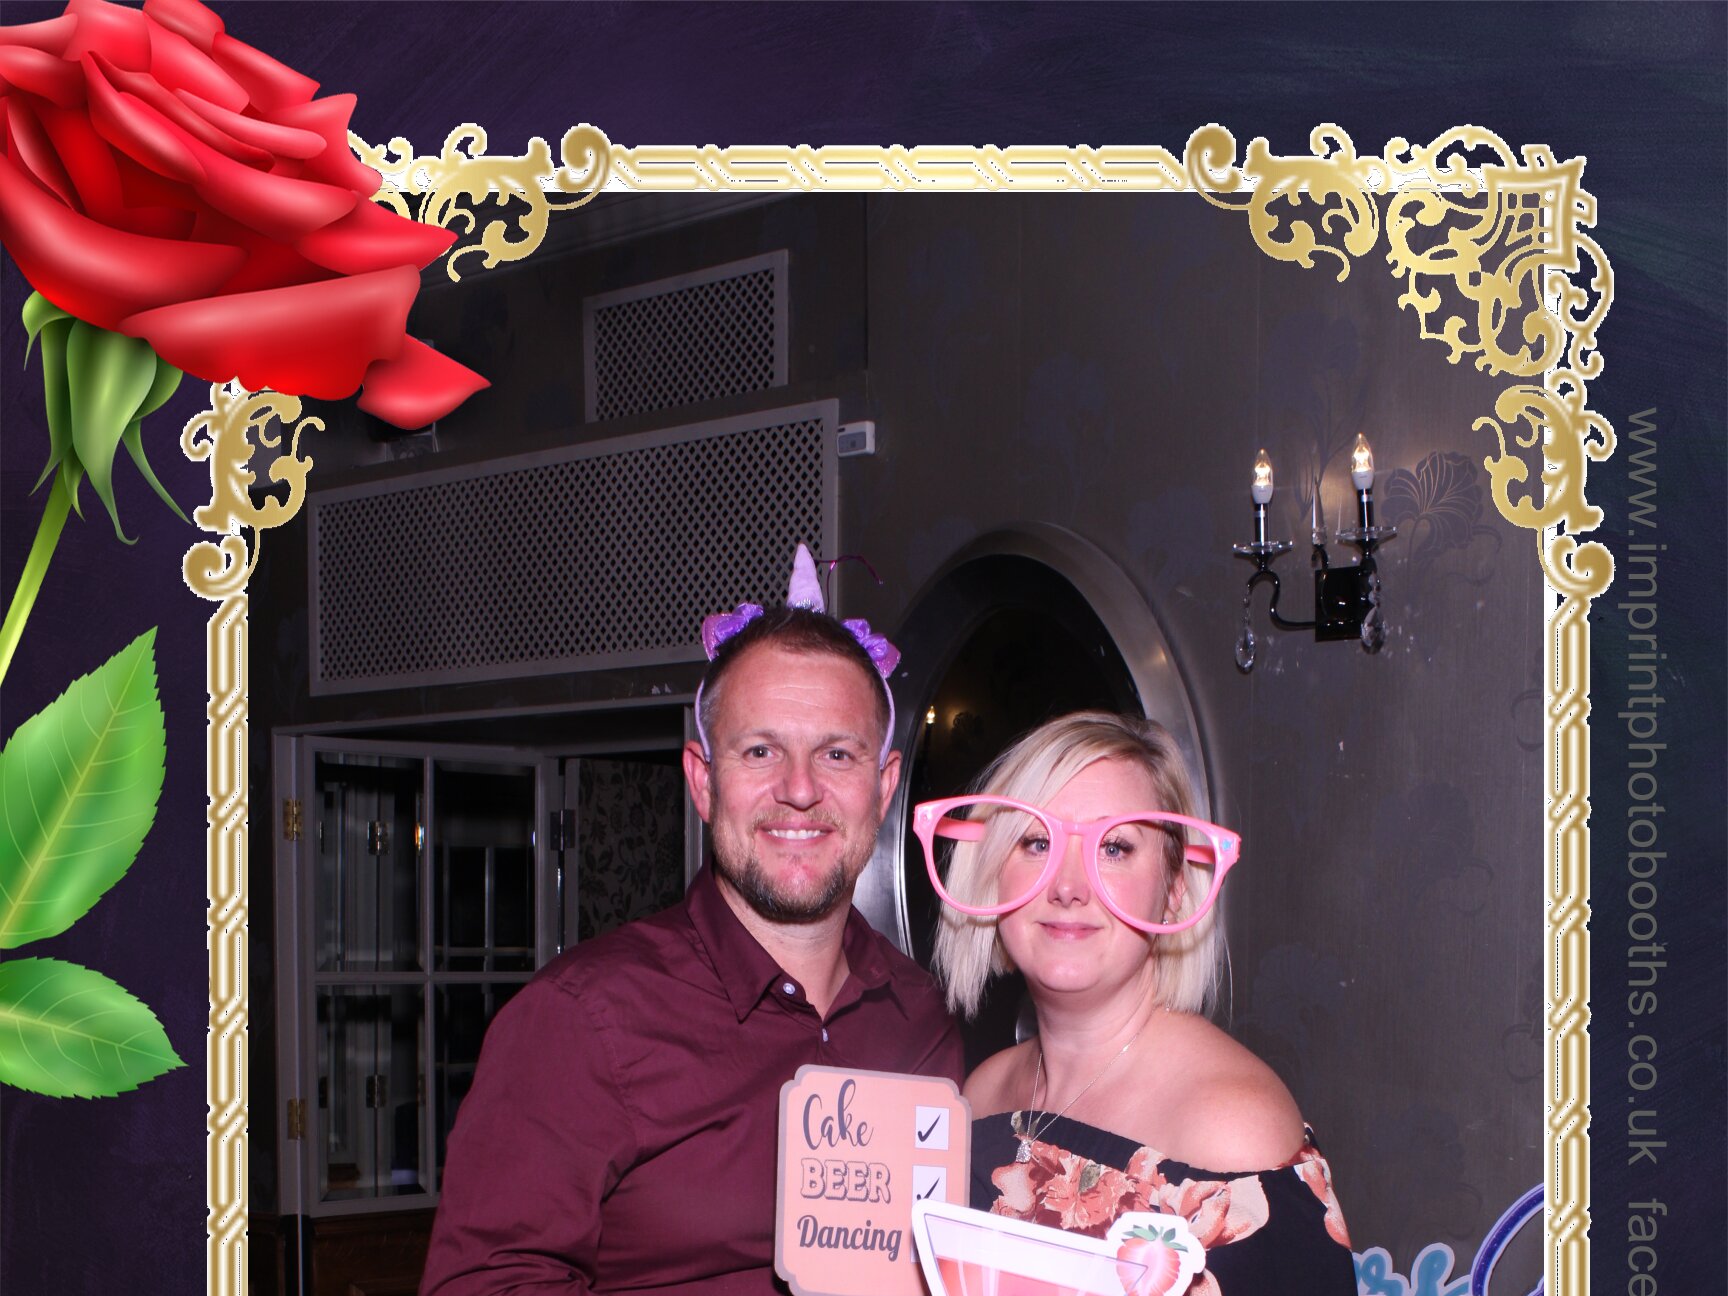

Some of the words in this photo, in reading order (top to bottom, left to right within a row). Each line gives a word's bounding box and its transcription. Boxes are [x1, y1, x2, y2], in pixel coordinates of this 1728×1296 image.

[803, 1079, 874, 1150] Cake
[800, 1158, 891, 1204] BEER
[797, 1215, 902, 1262] Dancing
